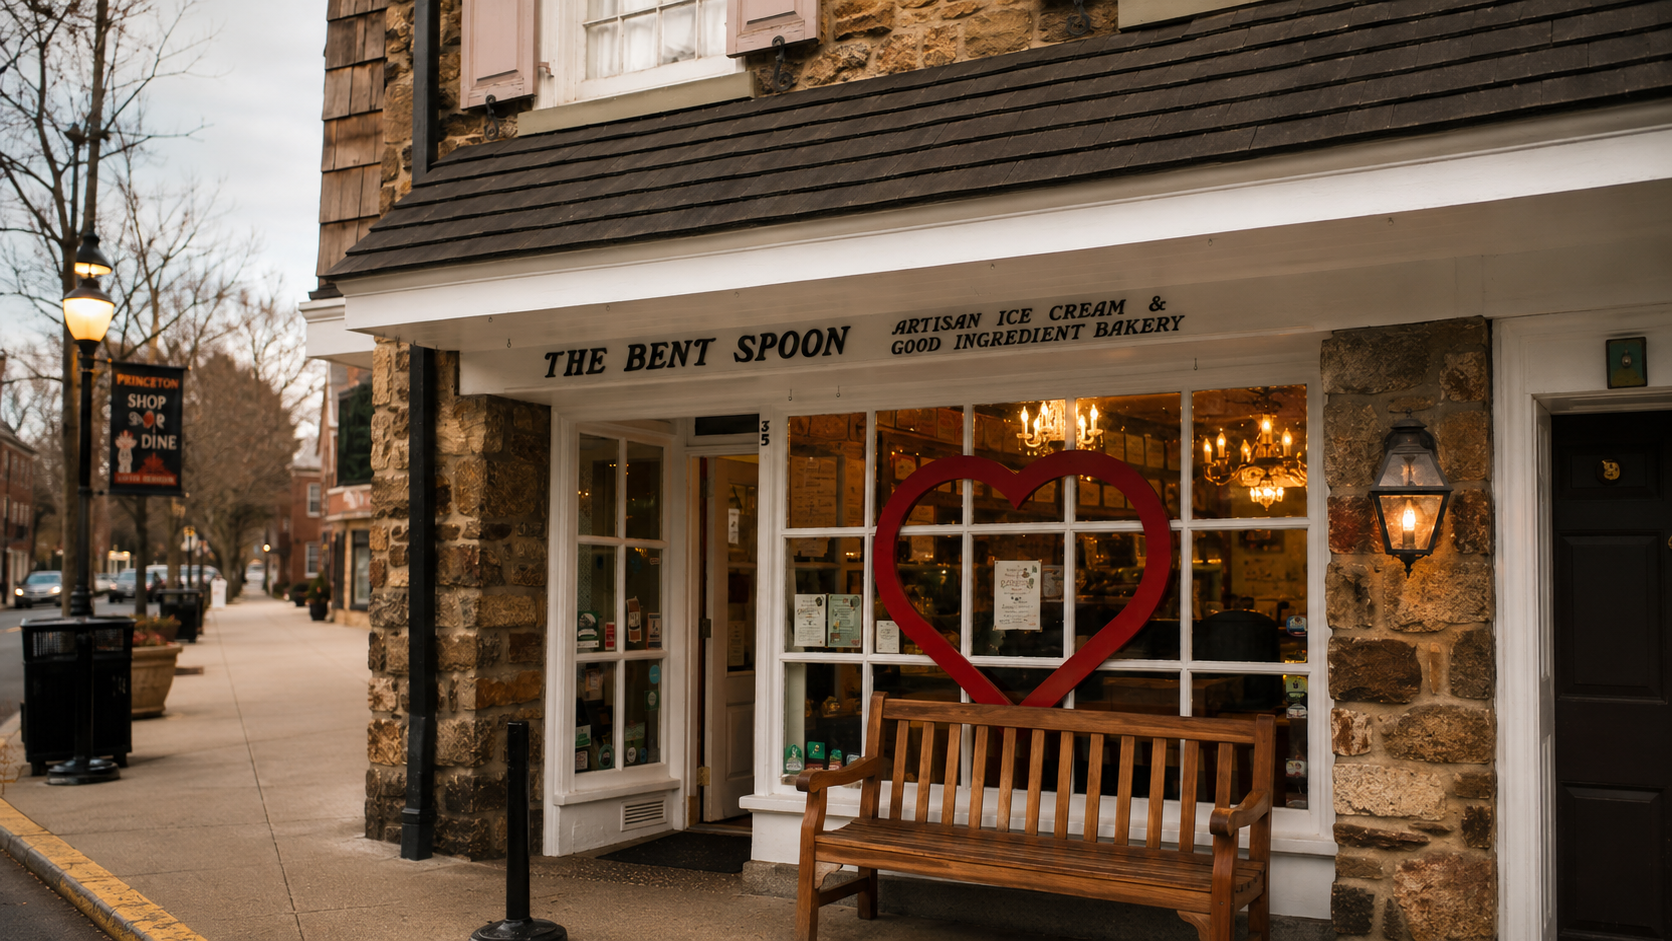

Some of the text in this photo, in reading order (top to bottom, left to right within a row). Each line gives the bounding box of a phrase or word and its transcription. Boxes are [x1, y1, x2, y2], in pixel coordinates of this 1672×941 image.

[891, 295, 1167, 336] ARTISAN ICE CREAM &
[890, 314, 1186, 355] GOOD INGREDIENT BAKERY
[544, 325, 852, 379] THE BENT SPOON
[116, 374, 179, 388] PRINCETON
[127, 393, 166, 409] SHOP
[141, 435, 176, 449] DINE
